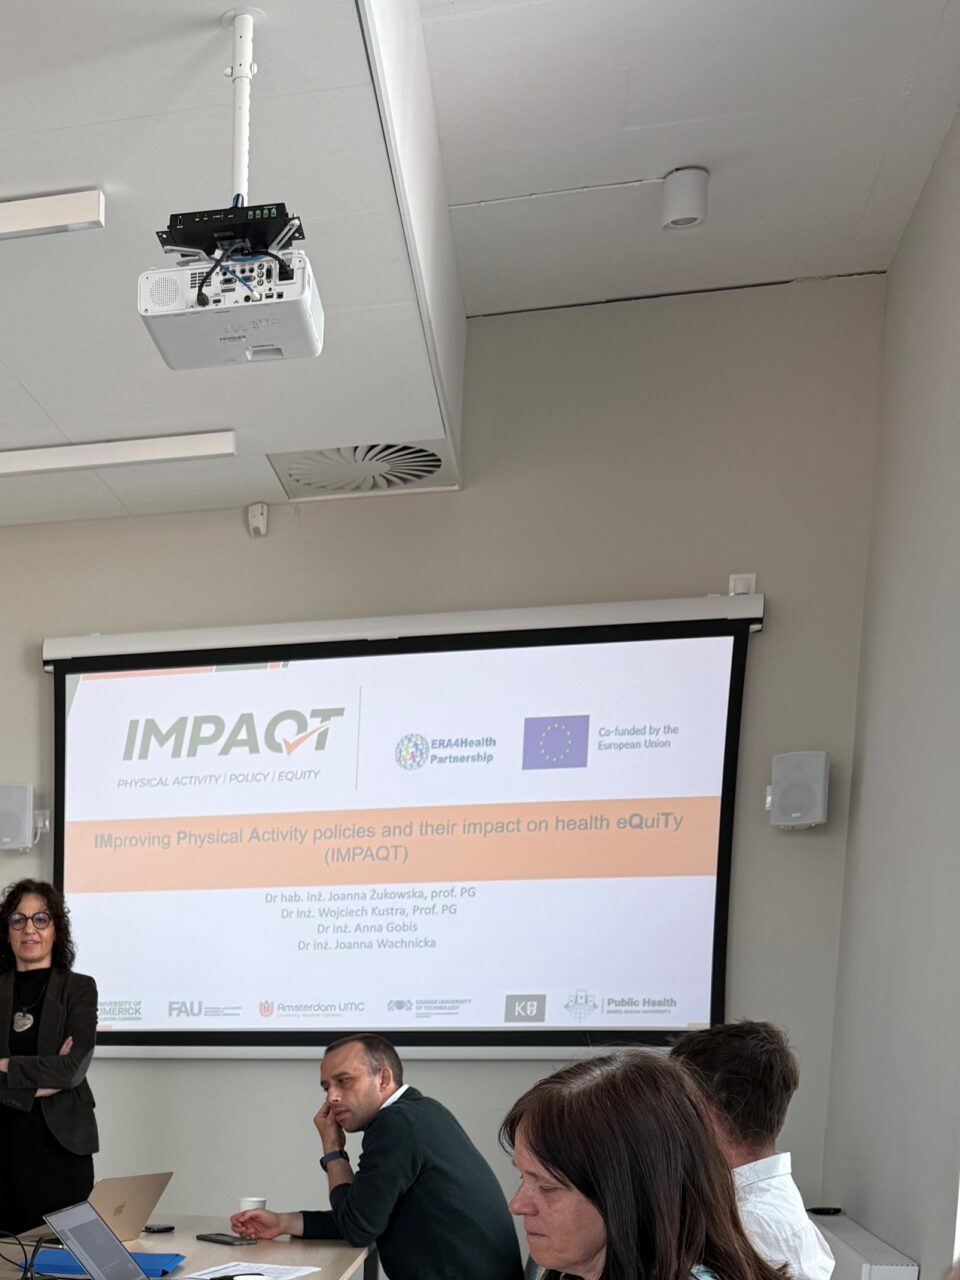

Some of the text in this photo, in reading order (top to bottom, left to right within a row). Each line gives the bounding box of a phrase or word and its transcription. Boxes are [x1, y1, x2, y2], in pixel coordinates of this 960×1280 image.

[122, 707, 345, 761] IMPAQT
[598, 724, 679, 738] Co-funded by the
[431, 737, 497, 750] ERA4Health
[598, 738, 671, 752] European Union
[429, 752, 494, 766] Partnership
[117, 768, 321, 789] PHYSICAL ACTIVITY POLICY EQUITY
[94, 812, 684, 850] IMproving Physical Activity policies and their impact on health eQuiTy
[324, 845, 409, 867] (IMPAQT)
[265, 893, 278, 903] Dr
[281, 891, 304, 903] hab.
[328, 890, 367, 902] Joanna
[370, 888, 427, 901] Żukowska,
[431, 886, 457, 902] prof.
[461, 886, 476, 898] PG
[281, 908, 294, 919] Dr
[318, 905, 368, 921] Wojciech
[371, 905, 409, 918] Kustra,
[413, 905, 438, 916] Prof.
[442, 904, 457, 915] PG
[317, 924, 330, 934] Dr
[355, 922, 383, 933] Anna
[386, 921, 418, 933] Gobis
[298, 940, 311, 950] Dr
[334, 939, 373, 950] Joanna
[376, 937, 437, 950] Wachnicka
[168, 1001, 203, 1017] FAU
[277, 1001, 365, 1012] Amsterdam UMC
[607, 997, 677, 1008] Public Health
